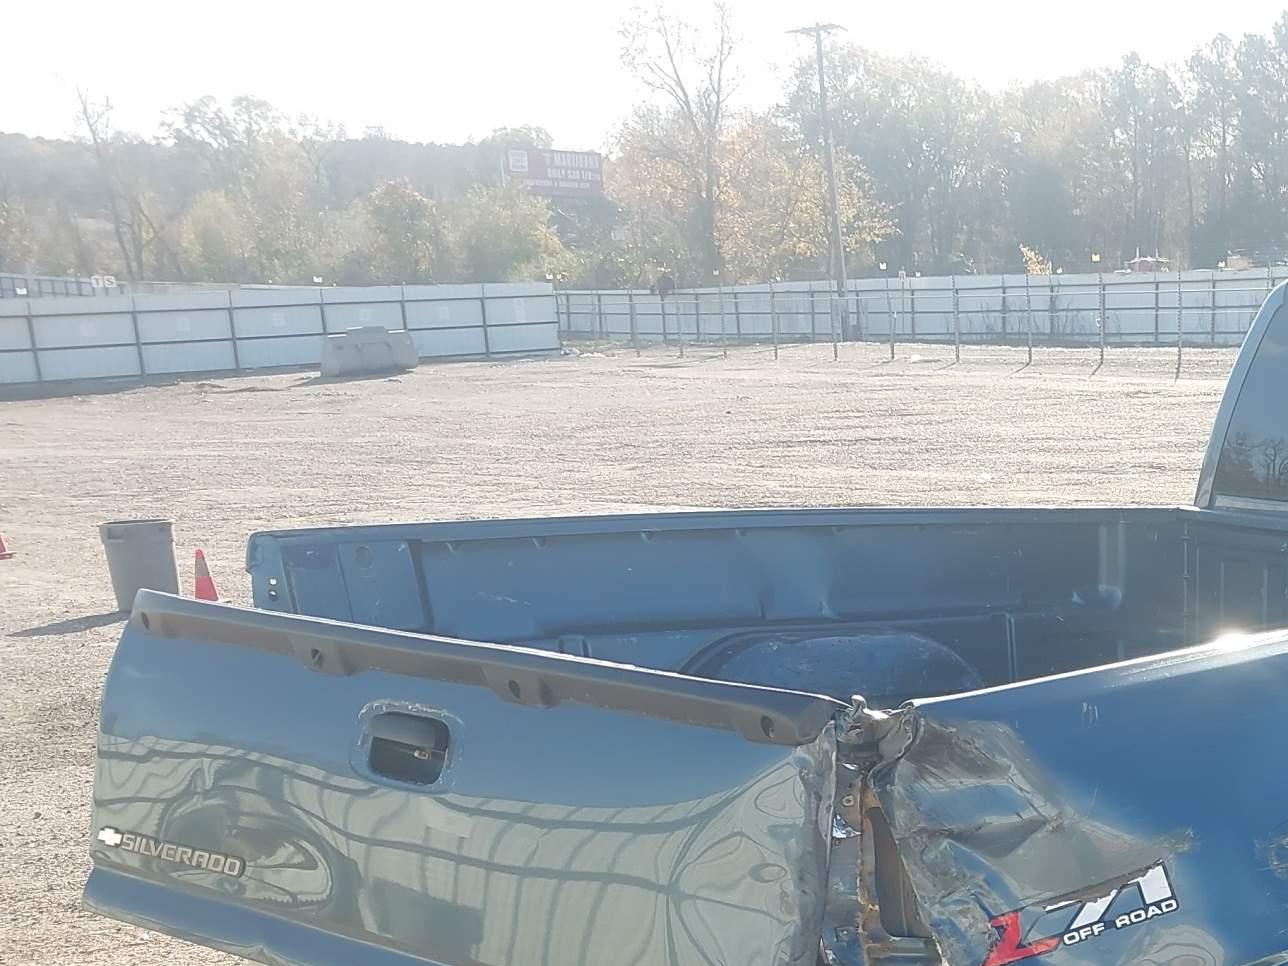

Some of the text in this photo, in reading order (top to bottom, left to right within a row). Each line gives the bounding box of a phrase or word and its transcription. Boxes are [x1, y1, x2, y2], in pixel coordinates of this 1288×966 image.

[119, 831, 243, 876] SILVERADO
[1063, 898, 1178, 946] OFF ROAD
